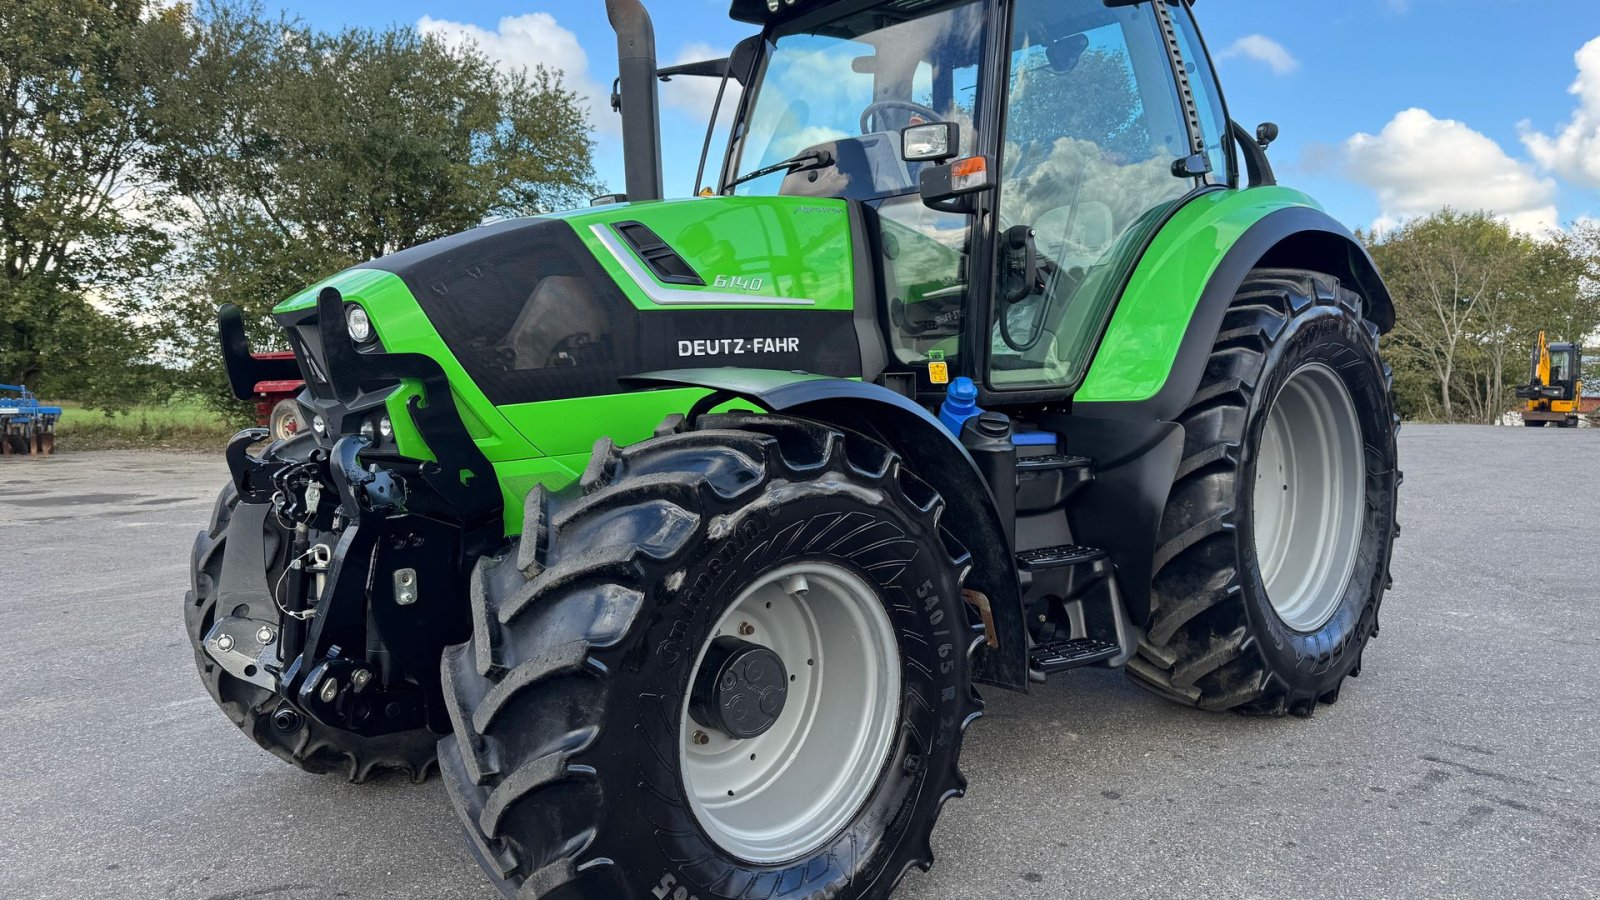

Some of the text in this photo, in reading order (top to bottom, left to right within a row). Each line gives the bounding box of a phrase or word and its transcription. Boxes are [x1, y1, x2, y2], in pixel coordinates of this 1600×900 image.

[713, 275, 763, 291] 6140
[678, 337, 800, 357] DEUTZ-FAHR
[916, 578, 954, 675] 540/65
[941, 686, 956, 702] R
